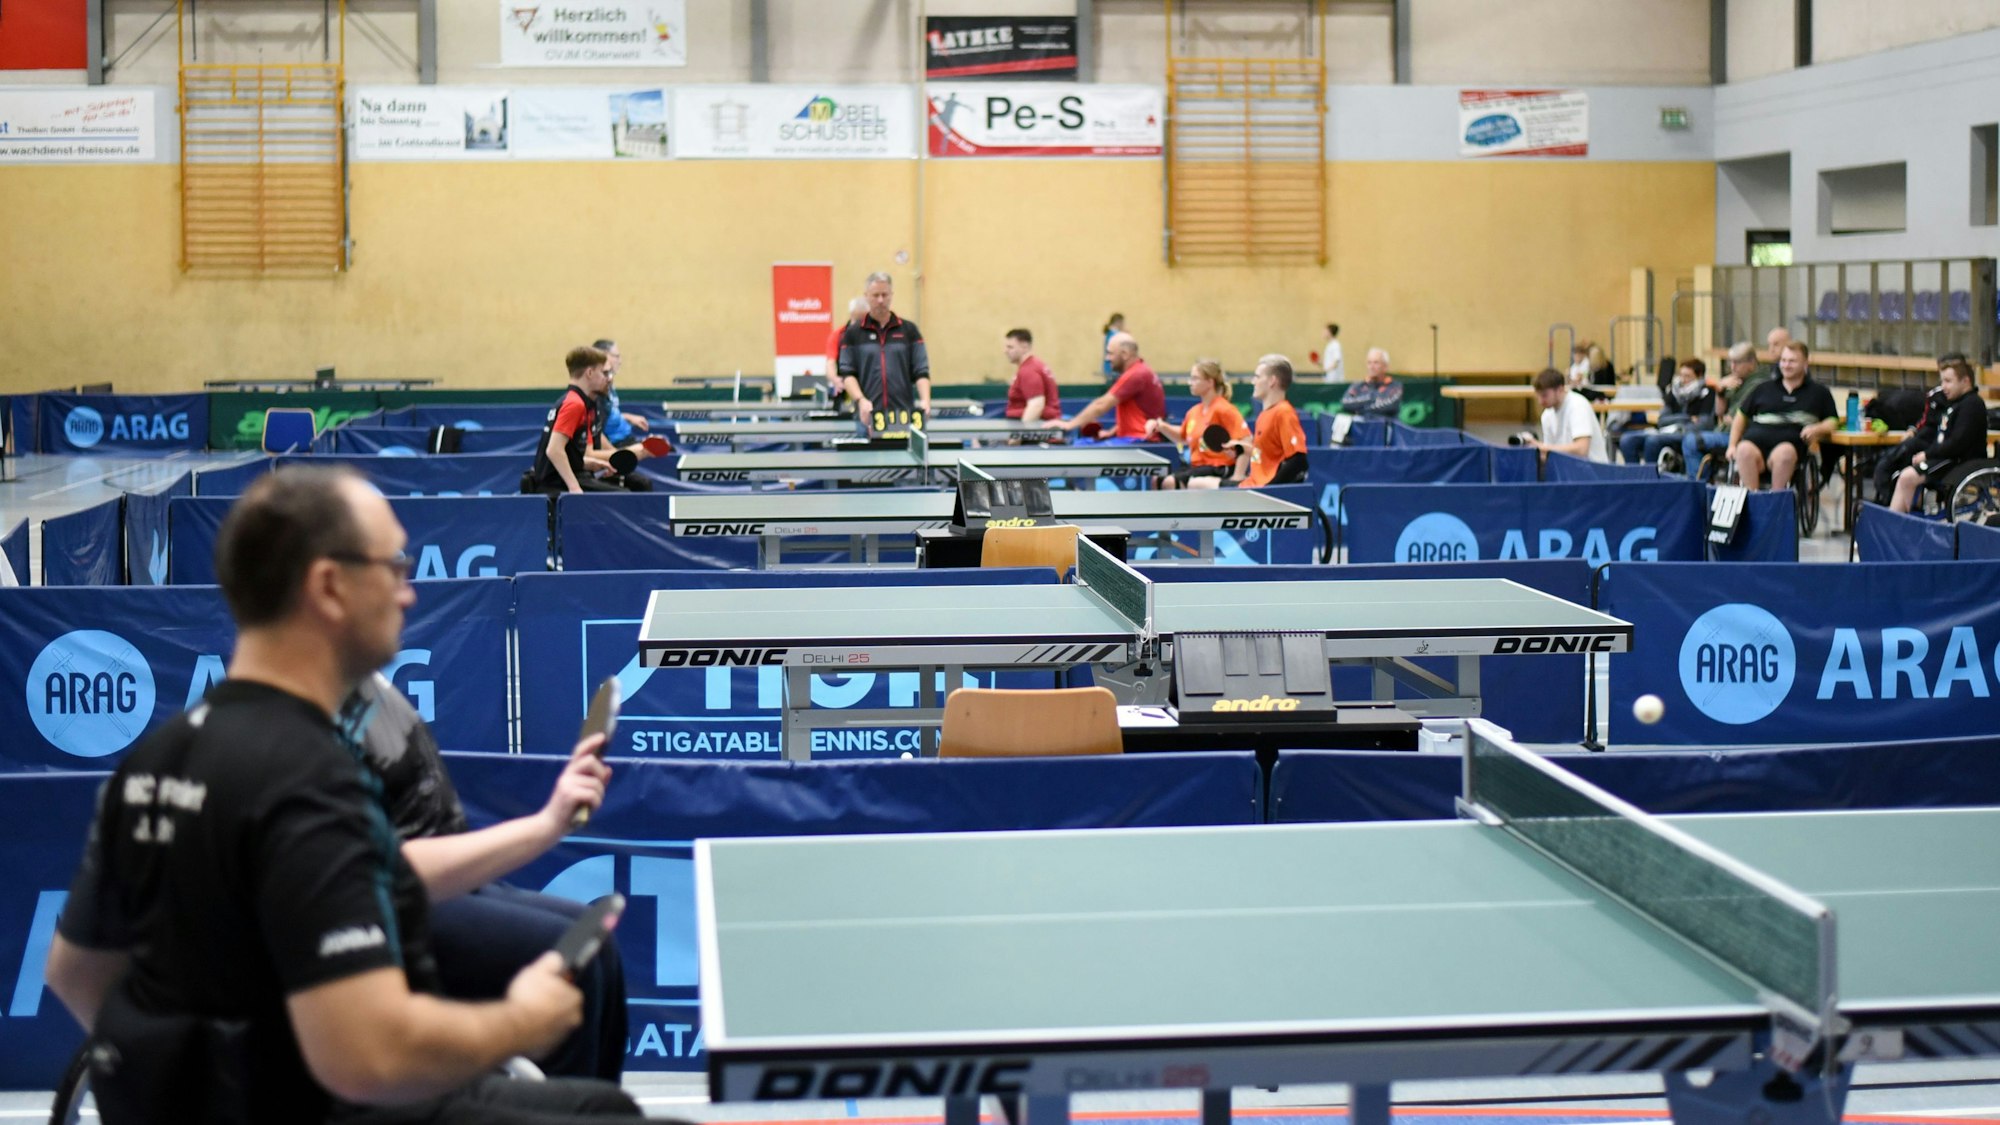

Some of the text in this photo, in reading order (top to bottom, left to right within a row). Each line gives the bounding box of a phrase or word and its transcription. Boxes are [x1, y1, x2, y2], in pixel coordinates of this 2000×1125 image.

[554, 7, 627, 22] Herzlich
[534, 29, 647, 43] willkommen!
[360, 99, 427, 112] Na dann
[986, 96, 1084, 129] Pe-S
[779, 124, 887, 140] SCHUSTER
[110, 413, 189, 440] ARAG
[874, 411, 885, 431] 3
[888, 410, 895, 424] 1
[911, 411, 922, 430] 3
[687, 471, 750, 481] DONIC
[1101, 467, 1162, 477] DONIC
[683, 524, 765, 535] DONIC
[985, 517, 1037, 527] andro
[1220, 518, 1300, 529] DONIC
[1493, 635, 1616, 654] DONIC
[659, 648, 788, 667] DONIC
[848, 653, 870, 663] 25
[1696, 626, 2000, 700] ARAG ARA
[45, 671, 137, 715] ARAG
[1212, 695, 1300, 712] andro
[754, 1059, 1032, 1100] DONIC
